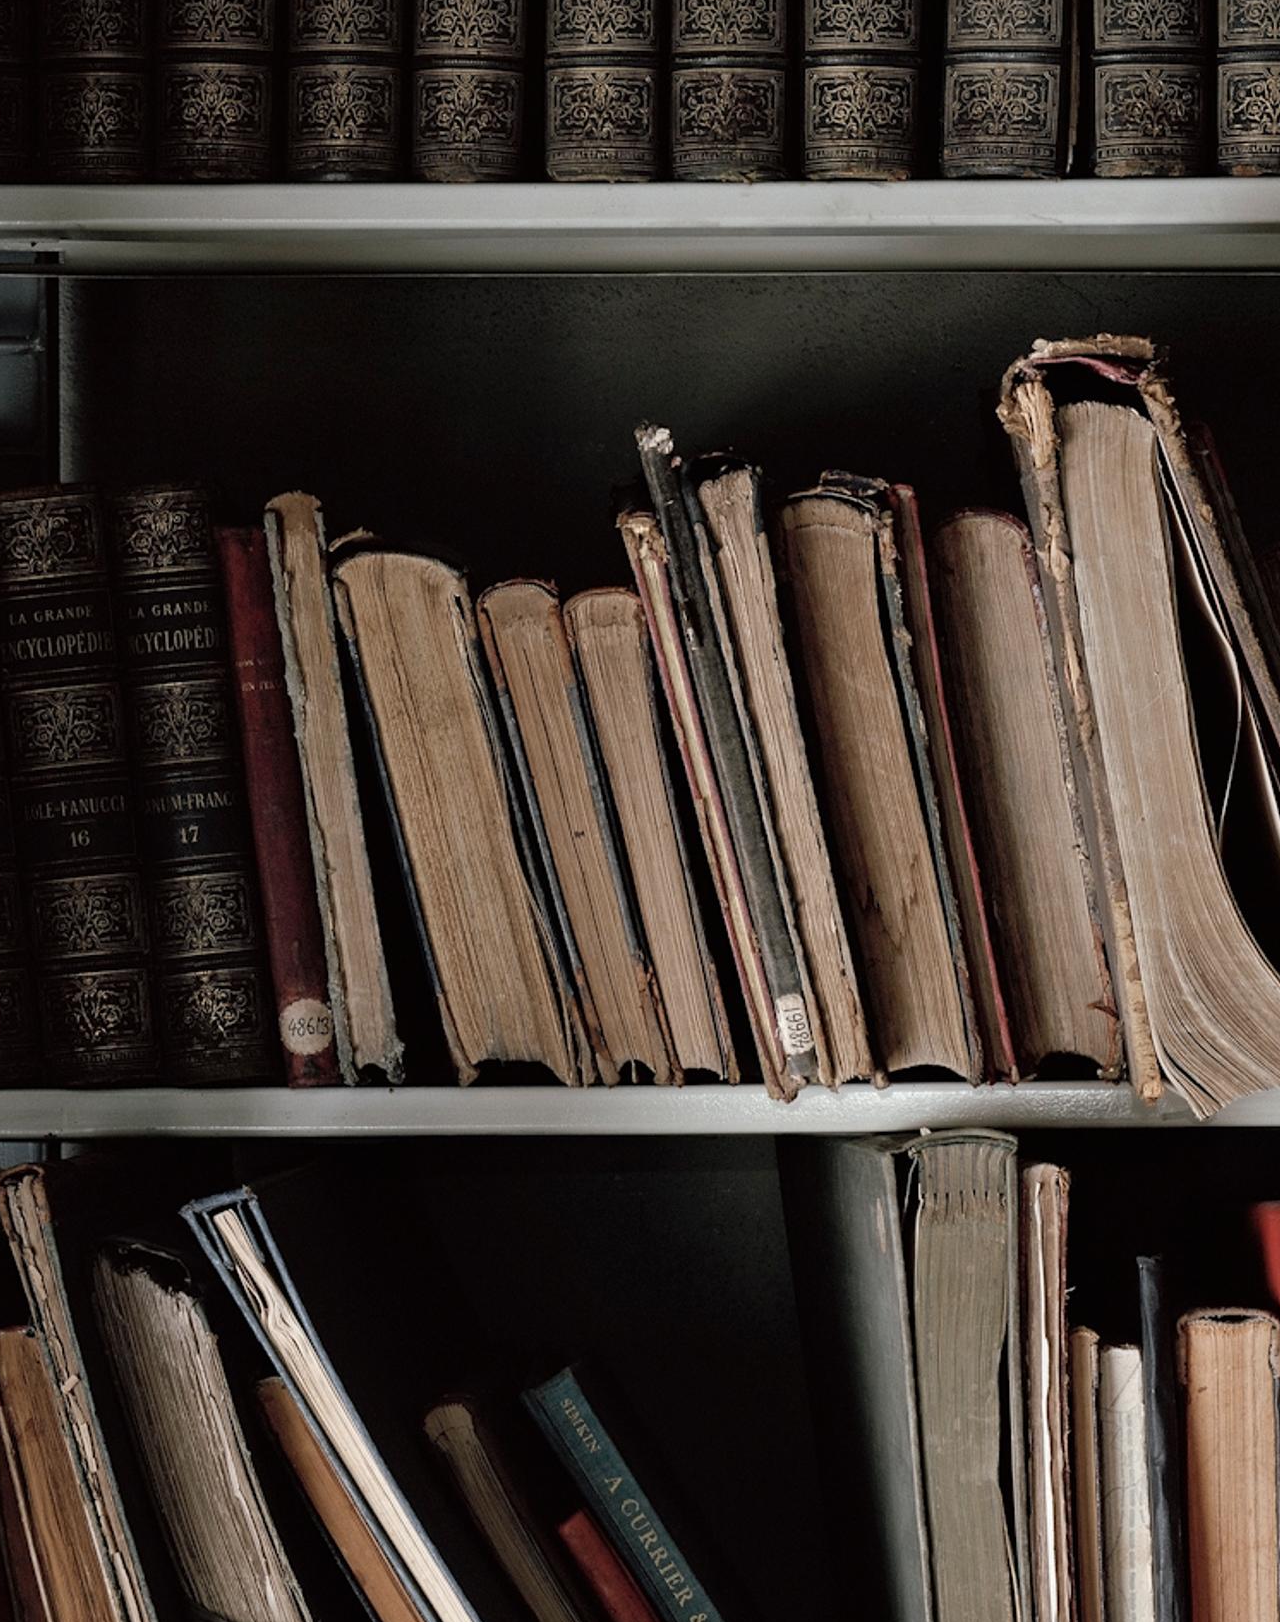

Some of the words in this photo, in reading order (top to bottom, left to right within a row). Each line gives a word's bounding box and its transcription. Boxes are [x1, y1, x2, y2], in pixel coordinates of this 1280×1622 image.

[9, 612, 28, 626] LA
[33, 603, 96, 623] GRANDE
[128, 608, 145, 620] LA
[151, 600, 211, 617] GRANDE
[70, 828, 91, 848] 16
[179, 824, 201, 844] 17
[560, 1397, 603, 1454] SIMKIN
[605, 1476, 623, 1495] A
[621, 1498, 695, 1608] CURRIER
